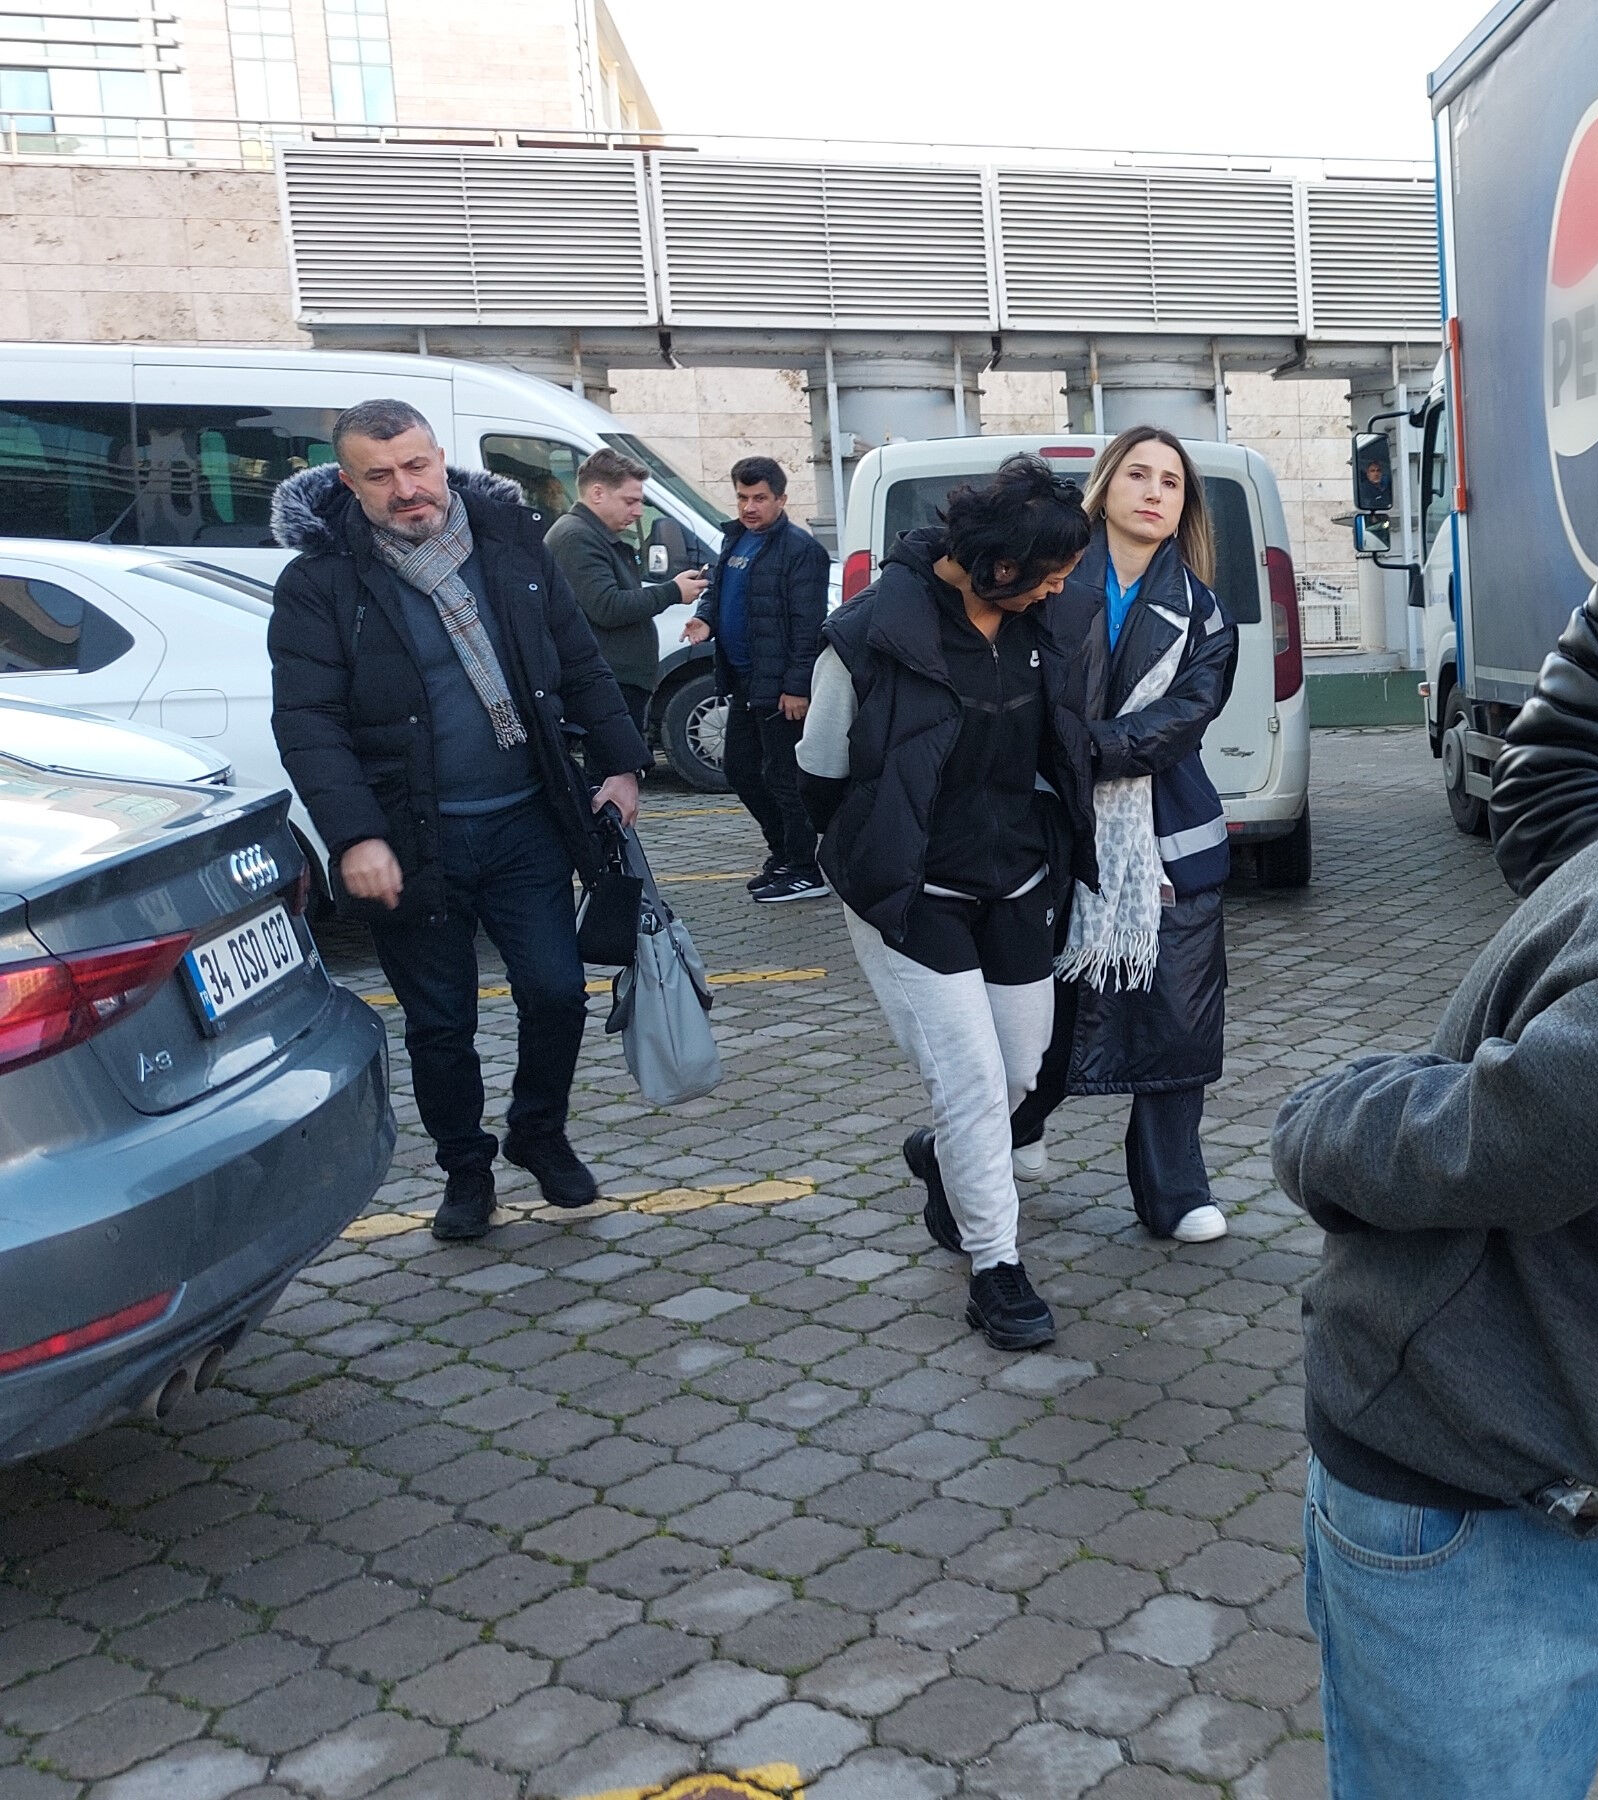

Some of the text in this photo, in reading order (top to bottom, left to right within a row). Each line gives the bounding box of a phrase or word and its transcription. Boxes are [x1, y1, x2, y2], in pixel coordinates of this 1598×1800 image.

[200, 949, 235, 1005] 34
[227, 928, 269, 990] DSD
[261, 912, 295, 969] 037
[200, 991, 212, 1006] TR
[137, 1050, 173, 1083] A3
